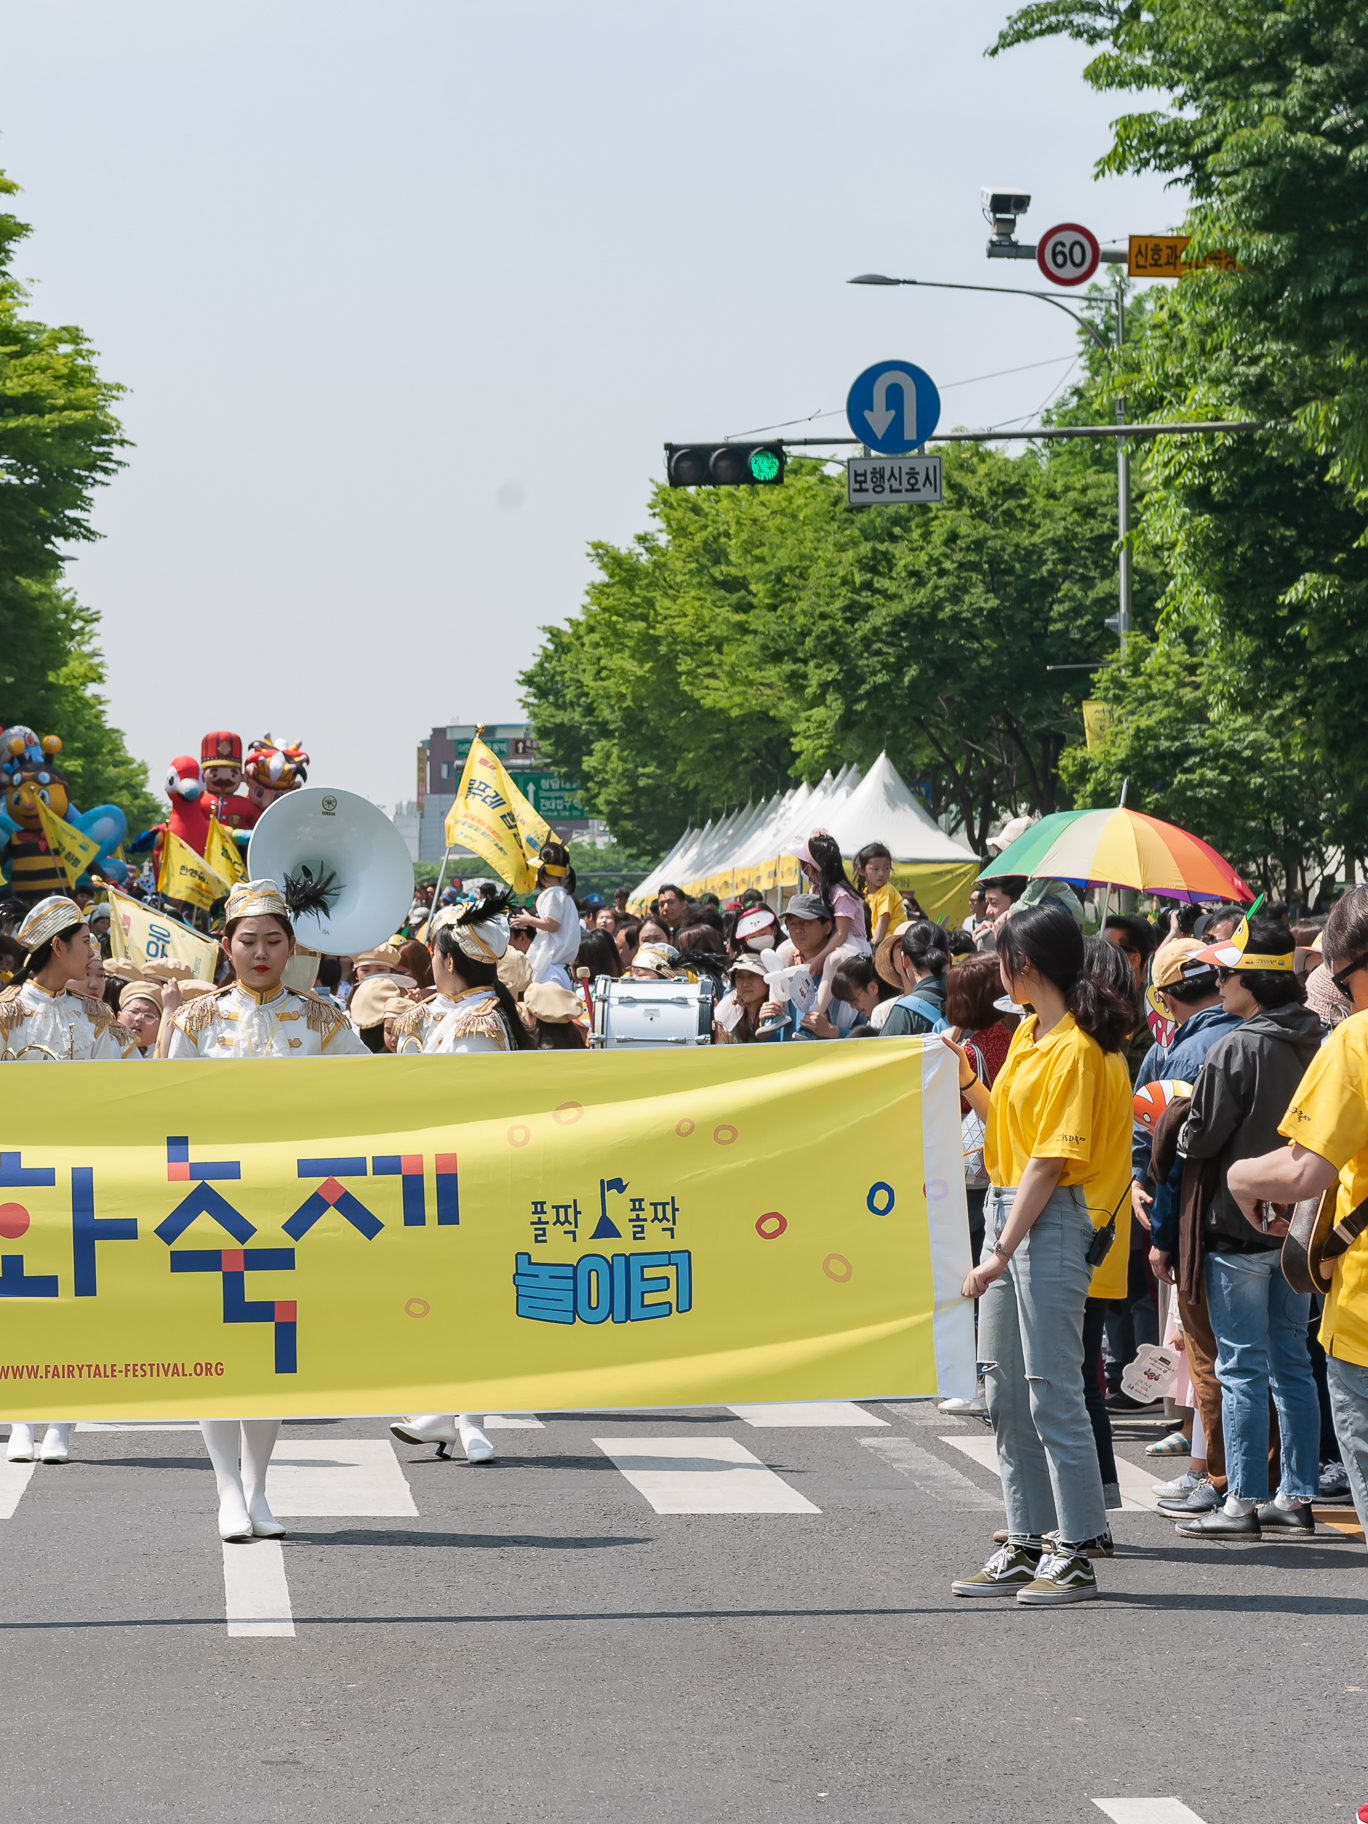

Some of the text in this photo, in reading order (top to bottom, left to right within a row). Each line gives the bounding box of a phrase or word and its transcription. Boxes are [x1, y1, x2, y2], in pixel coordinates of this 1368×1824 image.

[1051, 240, 1087, 269] 60
[853, 464, 937, 494] 보행신호시
[530, 1196, 680, 1243] 폴짝 폴짝
[513, 1249, 692, 1325] 놀이터
